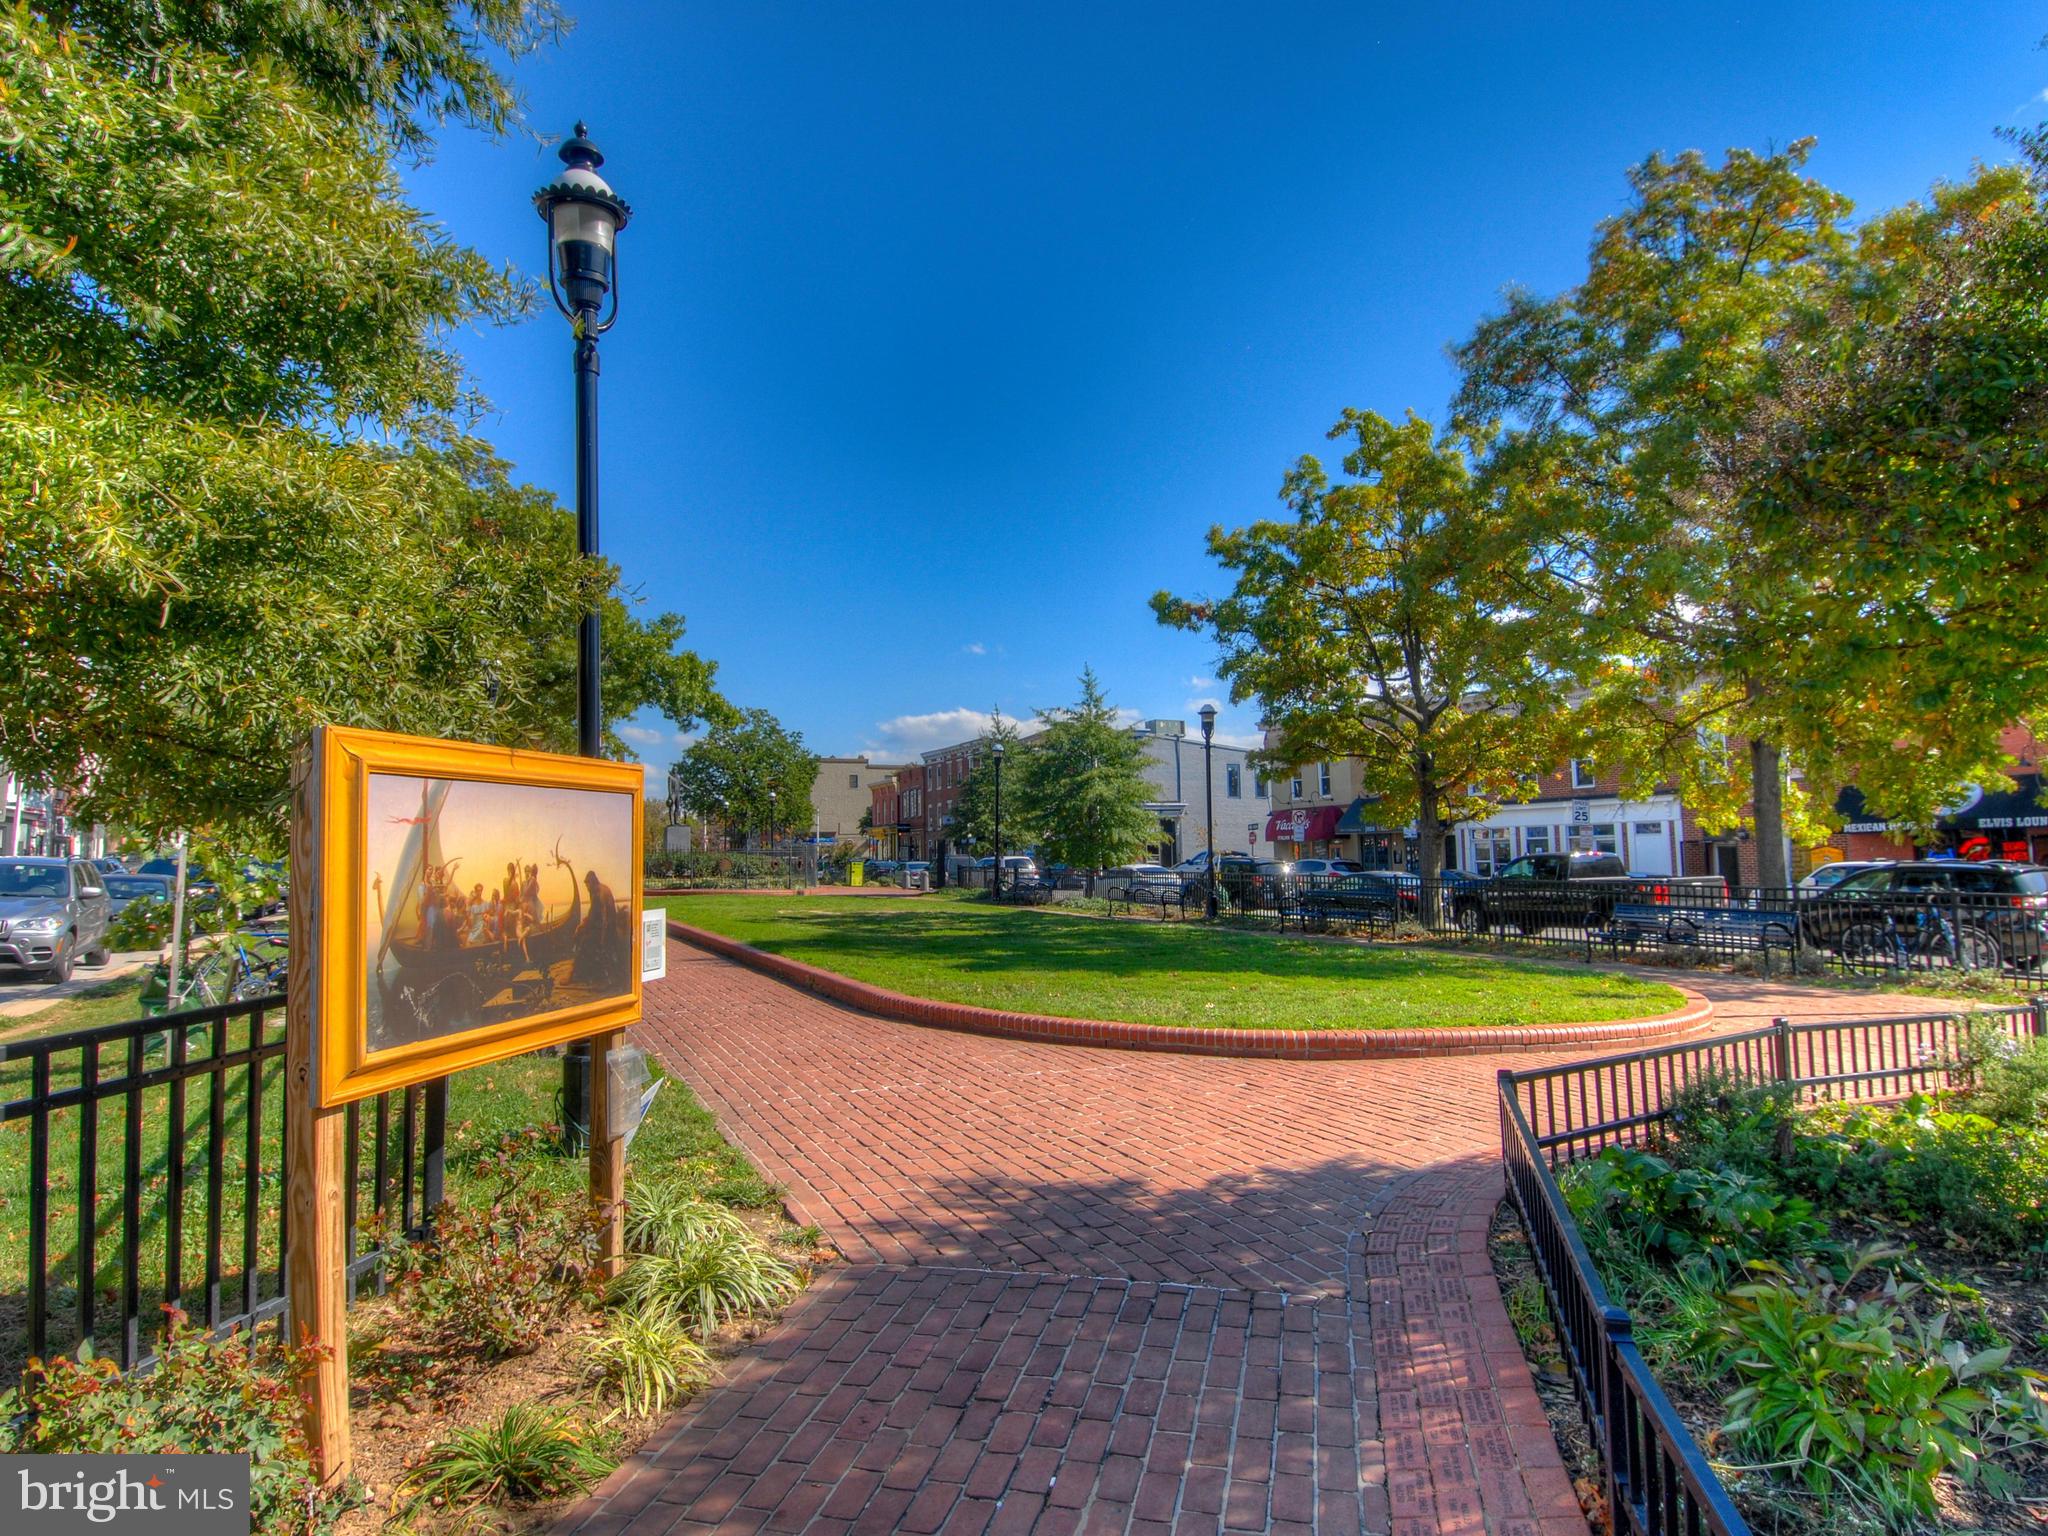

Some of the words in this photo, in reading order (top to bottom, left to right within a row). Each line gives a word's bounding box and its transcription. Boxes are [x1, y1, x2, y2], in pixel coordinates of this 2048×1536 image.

[1574, 811, 1588, 821] 25
[1843, 822, 1886, 833] MEXICAN
[1977, 817, 2013, 828] ELVIS
